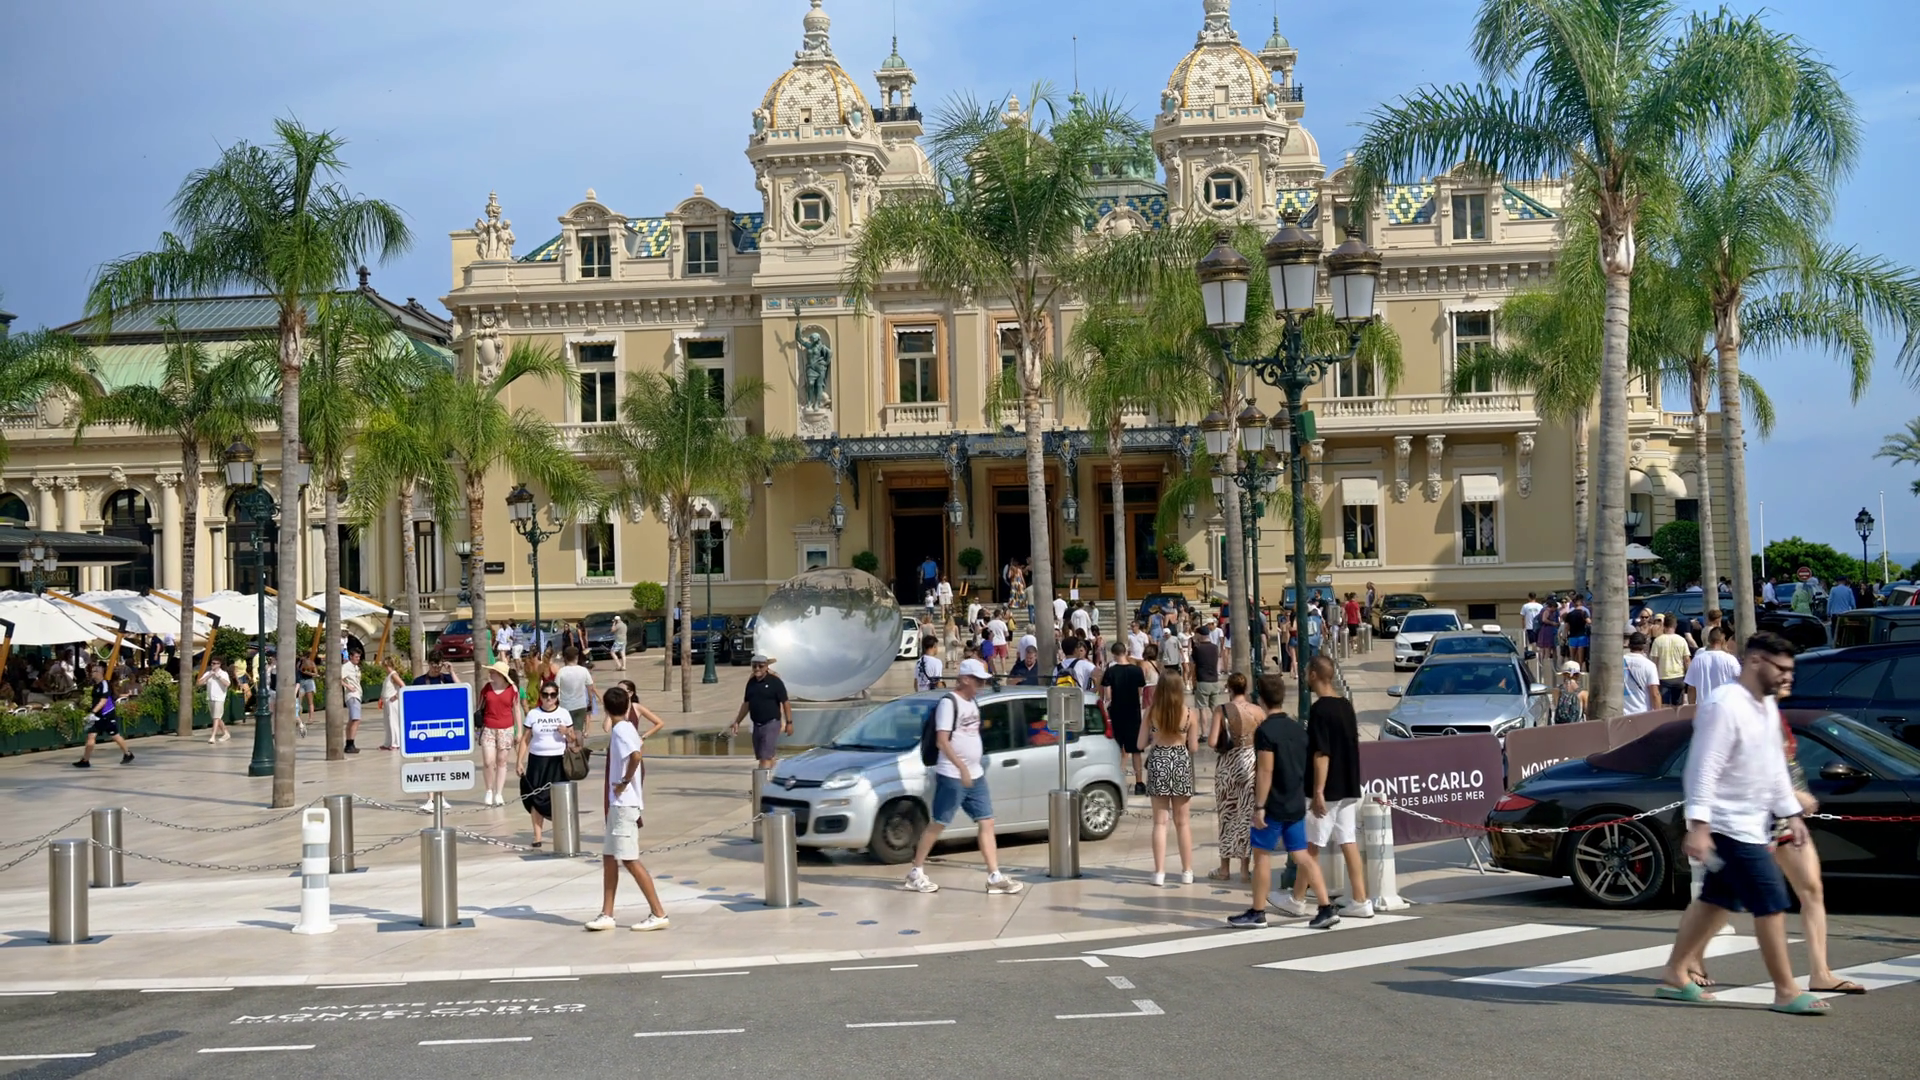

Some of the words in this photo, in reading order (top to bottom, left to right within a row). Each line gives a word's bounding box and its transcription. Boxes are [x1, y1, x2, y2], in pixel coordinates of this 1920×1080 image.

[1345, 560, 1376, 568] GRAFF
[406, 772, 447, 783] NAVETTE
[449, 771, 470, 781] SBM
[1401, 796, 1420, 807] DES
[1422, 793, 1449, 805] BAINS
[1451, 792, 1463, 802] DE
[1465, 790, 1485, 801] MER
